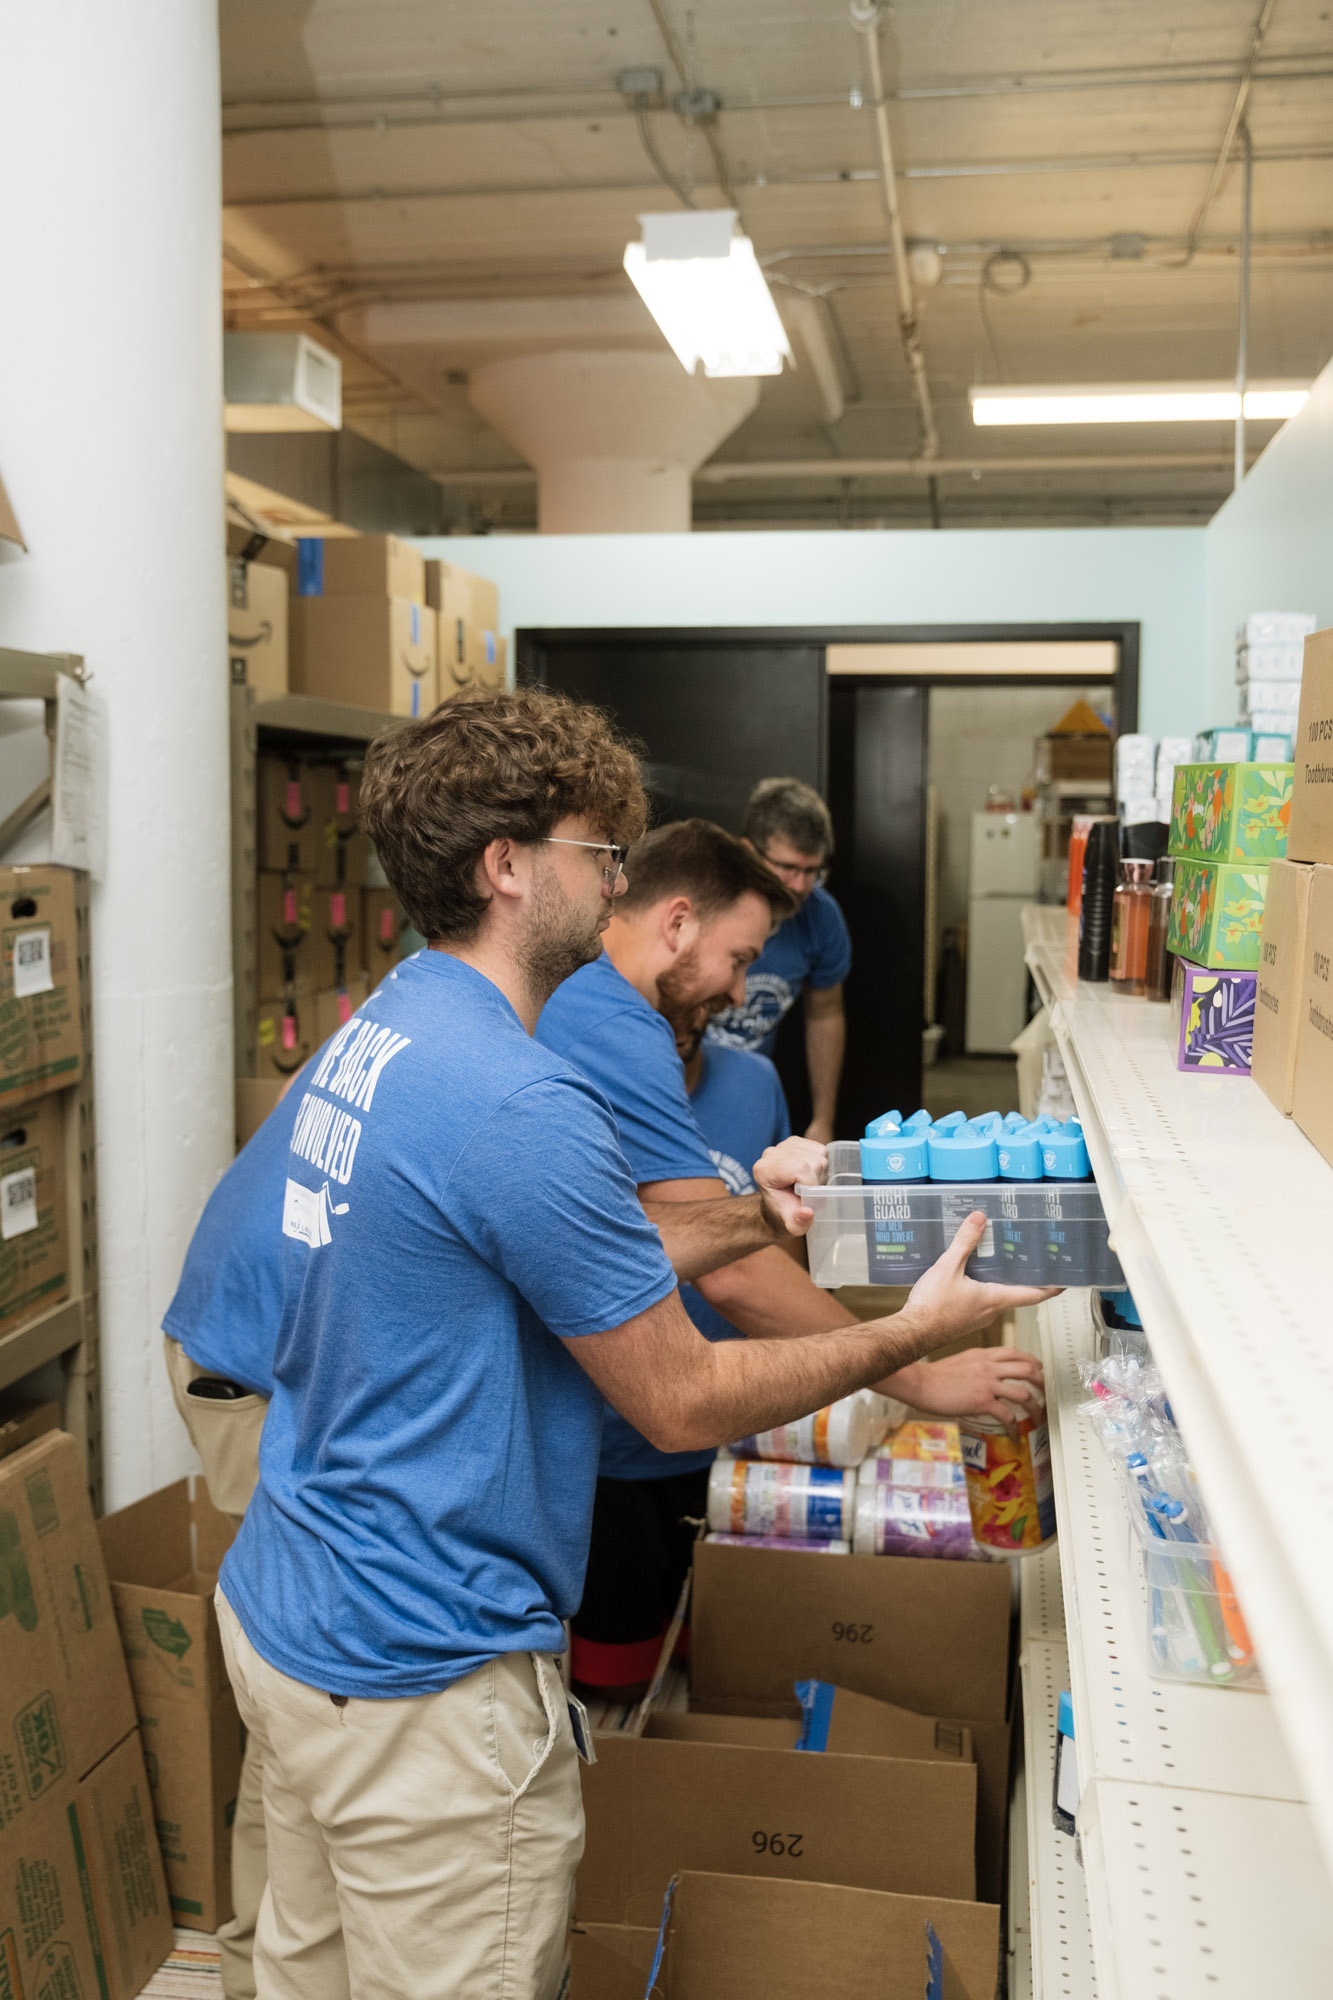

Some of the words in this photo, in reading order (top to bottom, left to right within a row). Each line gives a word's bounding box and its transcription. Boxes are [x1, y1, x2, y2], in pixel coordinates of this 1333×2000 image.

[1308, 721, 1319, 742] 100
[1319, 718, 1333, 741] PCS
[1305, 762, 1333, 783] Toothbrus
[328, 1020, 412, 1113] BACK
[873, 1188, 908, 1205] RIGHT
[874, 1204, 911, 1220] GUARD
[1001, 1203, 1018, 1219] ARD
[1045, 1204, 1062, 1219] ARD
[888, 1220, 903, 1231] MEN
[875, 1231, 890, 1242] WHO
[831, 1621, 873, 1644] 296
[752, 1831, 804, 1857] 296
